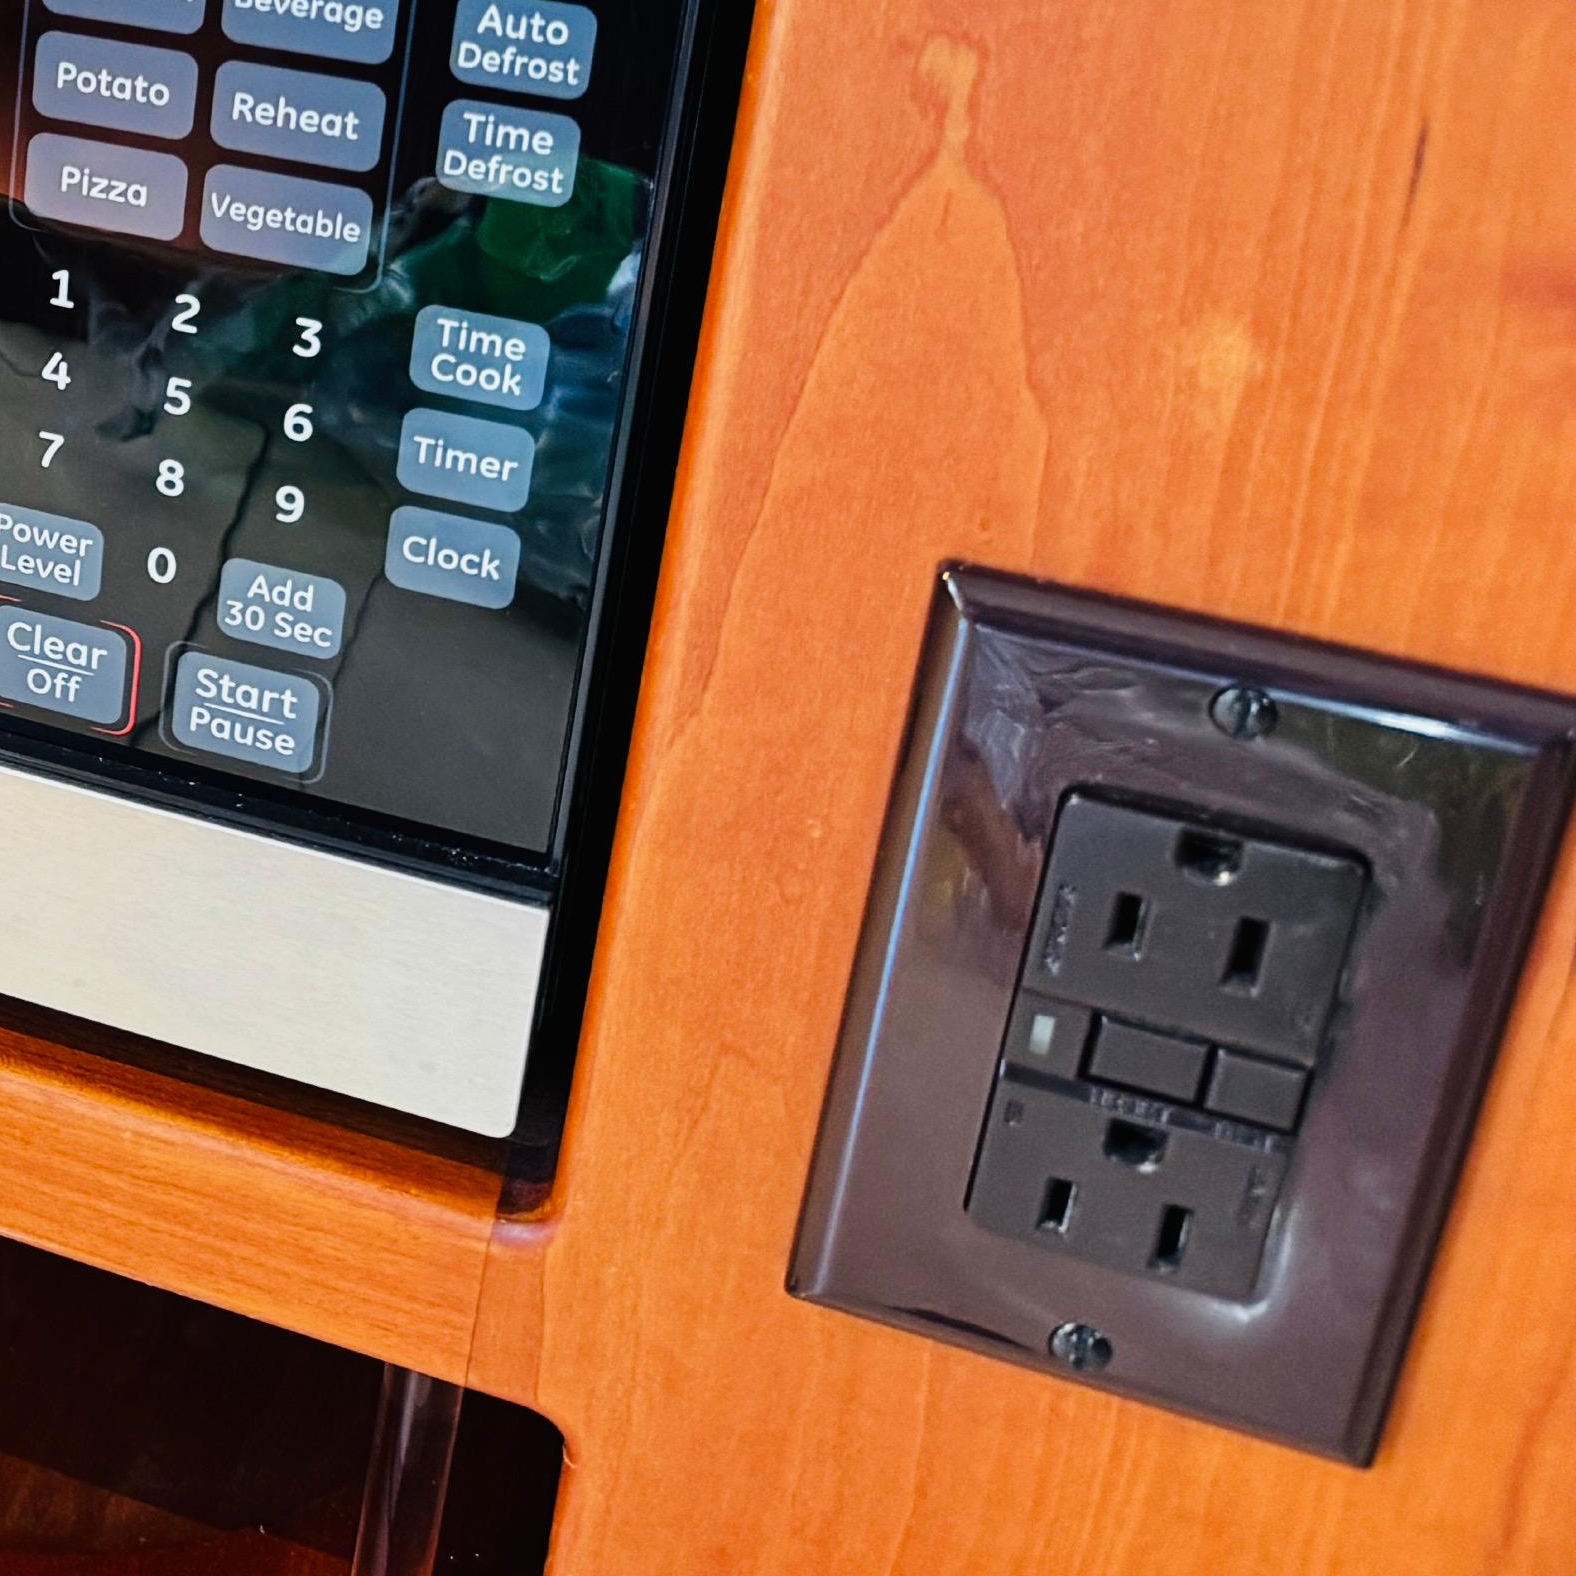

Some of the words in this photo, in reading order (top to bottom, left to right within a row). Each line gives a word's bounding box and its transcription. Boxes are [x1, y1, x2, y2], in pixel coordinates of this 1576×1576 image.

[477, 4, 569, 45] Auto
[57, 61, 170, 106] Potato
[457, 39, 580, 86] Defrost
[232, 92, 360, 140] Reheat
[463, 112, 554, 156] Time
[61, 165, 148, 207] Pizza
[443, 148, 564, 194] Defrost
[211, 192, 361, 243] Vegetable
[49, 269, 75, 309] 1
[171, 293, 201, 334] 2
[292, 317, 323, 358] 3
[436, 318, 526, 362] Time
[41, 351, 72, 391] 4
[431, 351, 523, 396] Cook
[163, 376, 192, 416] 5
[283, 403, 313, 442] 6
[39, 430, 65, 468] 7
[413, 435, 519, 482] Timer
[155, 458, 185, 497] 8
[275, 485, 305, 523] 9
[0, 542, 84, 586] Level
[147, 546, 177, 584] 0
[402, 535, 500, 580] Clock
[247, 574, 314, 613] Add
[7, 621, 108, 670] Clear
[224, 600, 265, 631] 30
[273, 611, 333, 648] Sec
[26, 665, 84, 702] Off
[195, 668, 298, 720] Start
[189, 705, 297, 756] Pause
